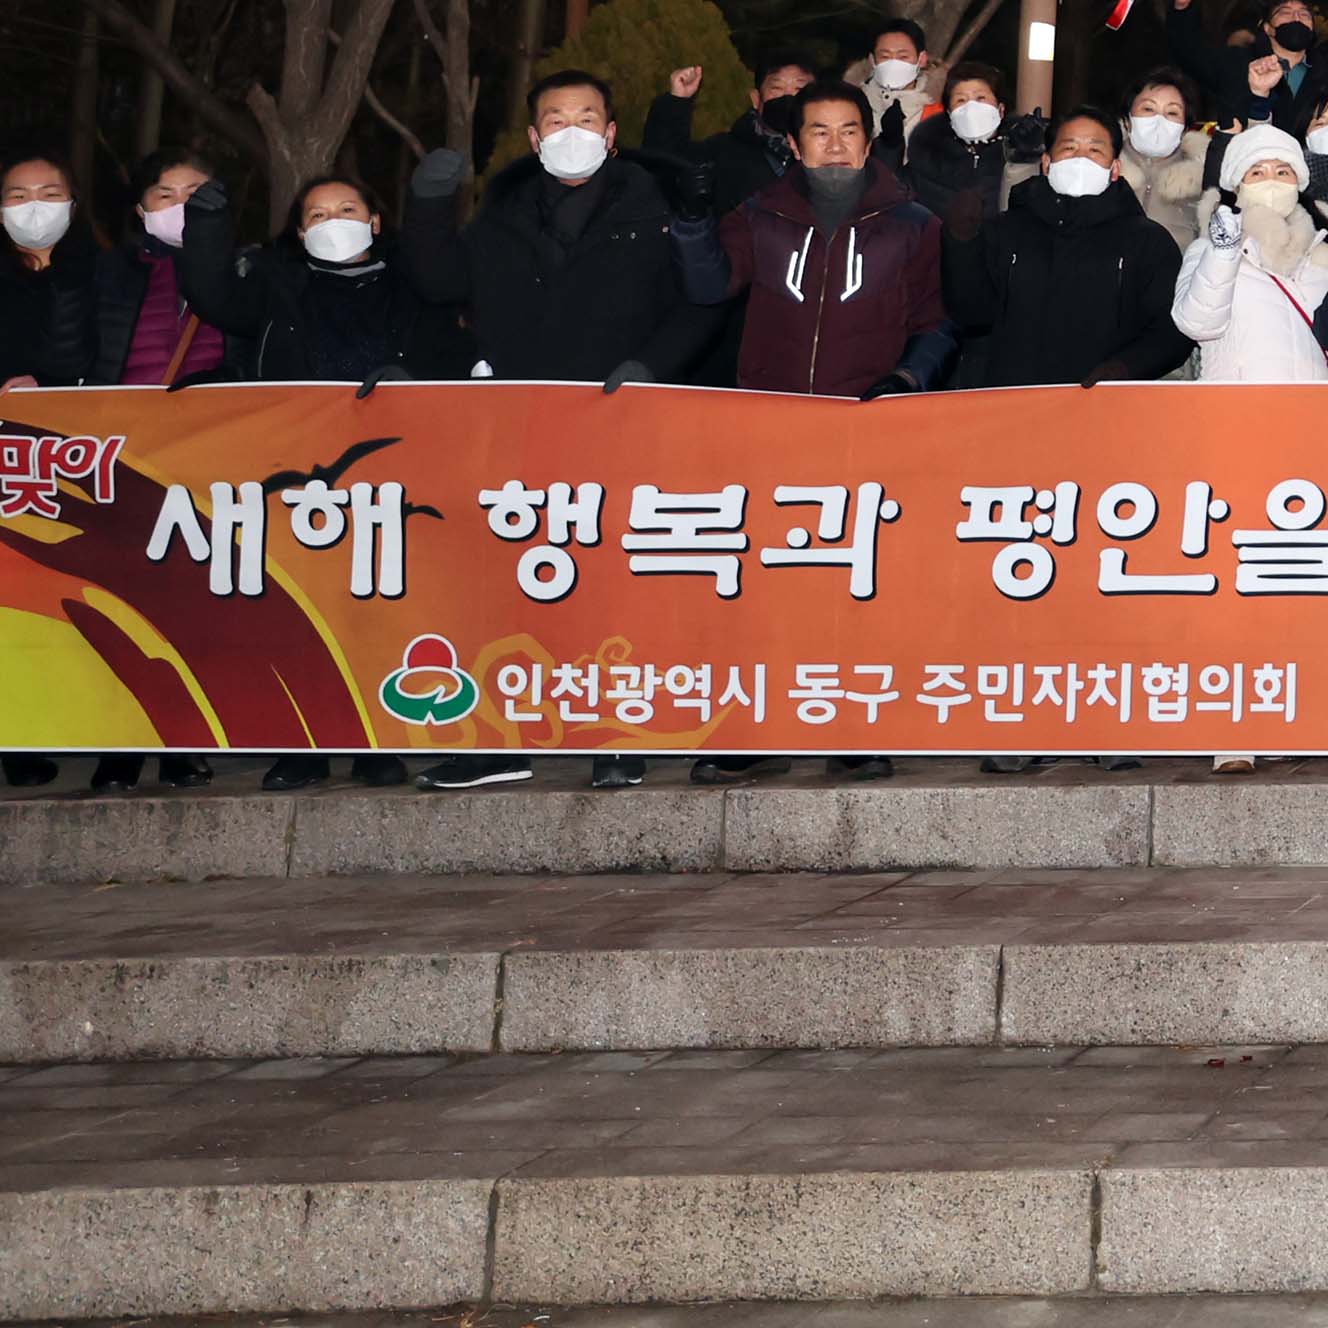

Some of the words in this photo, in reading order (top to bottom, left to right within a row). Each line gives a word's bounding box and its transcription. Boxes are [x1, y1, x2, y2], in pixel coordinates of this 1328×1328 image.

[0, 435, 126, 519] 맞이
[145, 479, 405, 598] 새해
[477, 478, 902, 601] 행복과
[496, 662, 767, 724] 인천광역시
[787, 663, 900, 724] 동구
[916, 662, 1298, 724] 주민자치협의회
